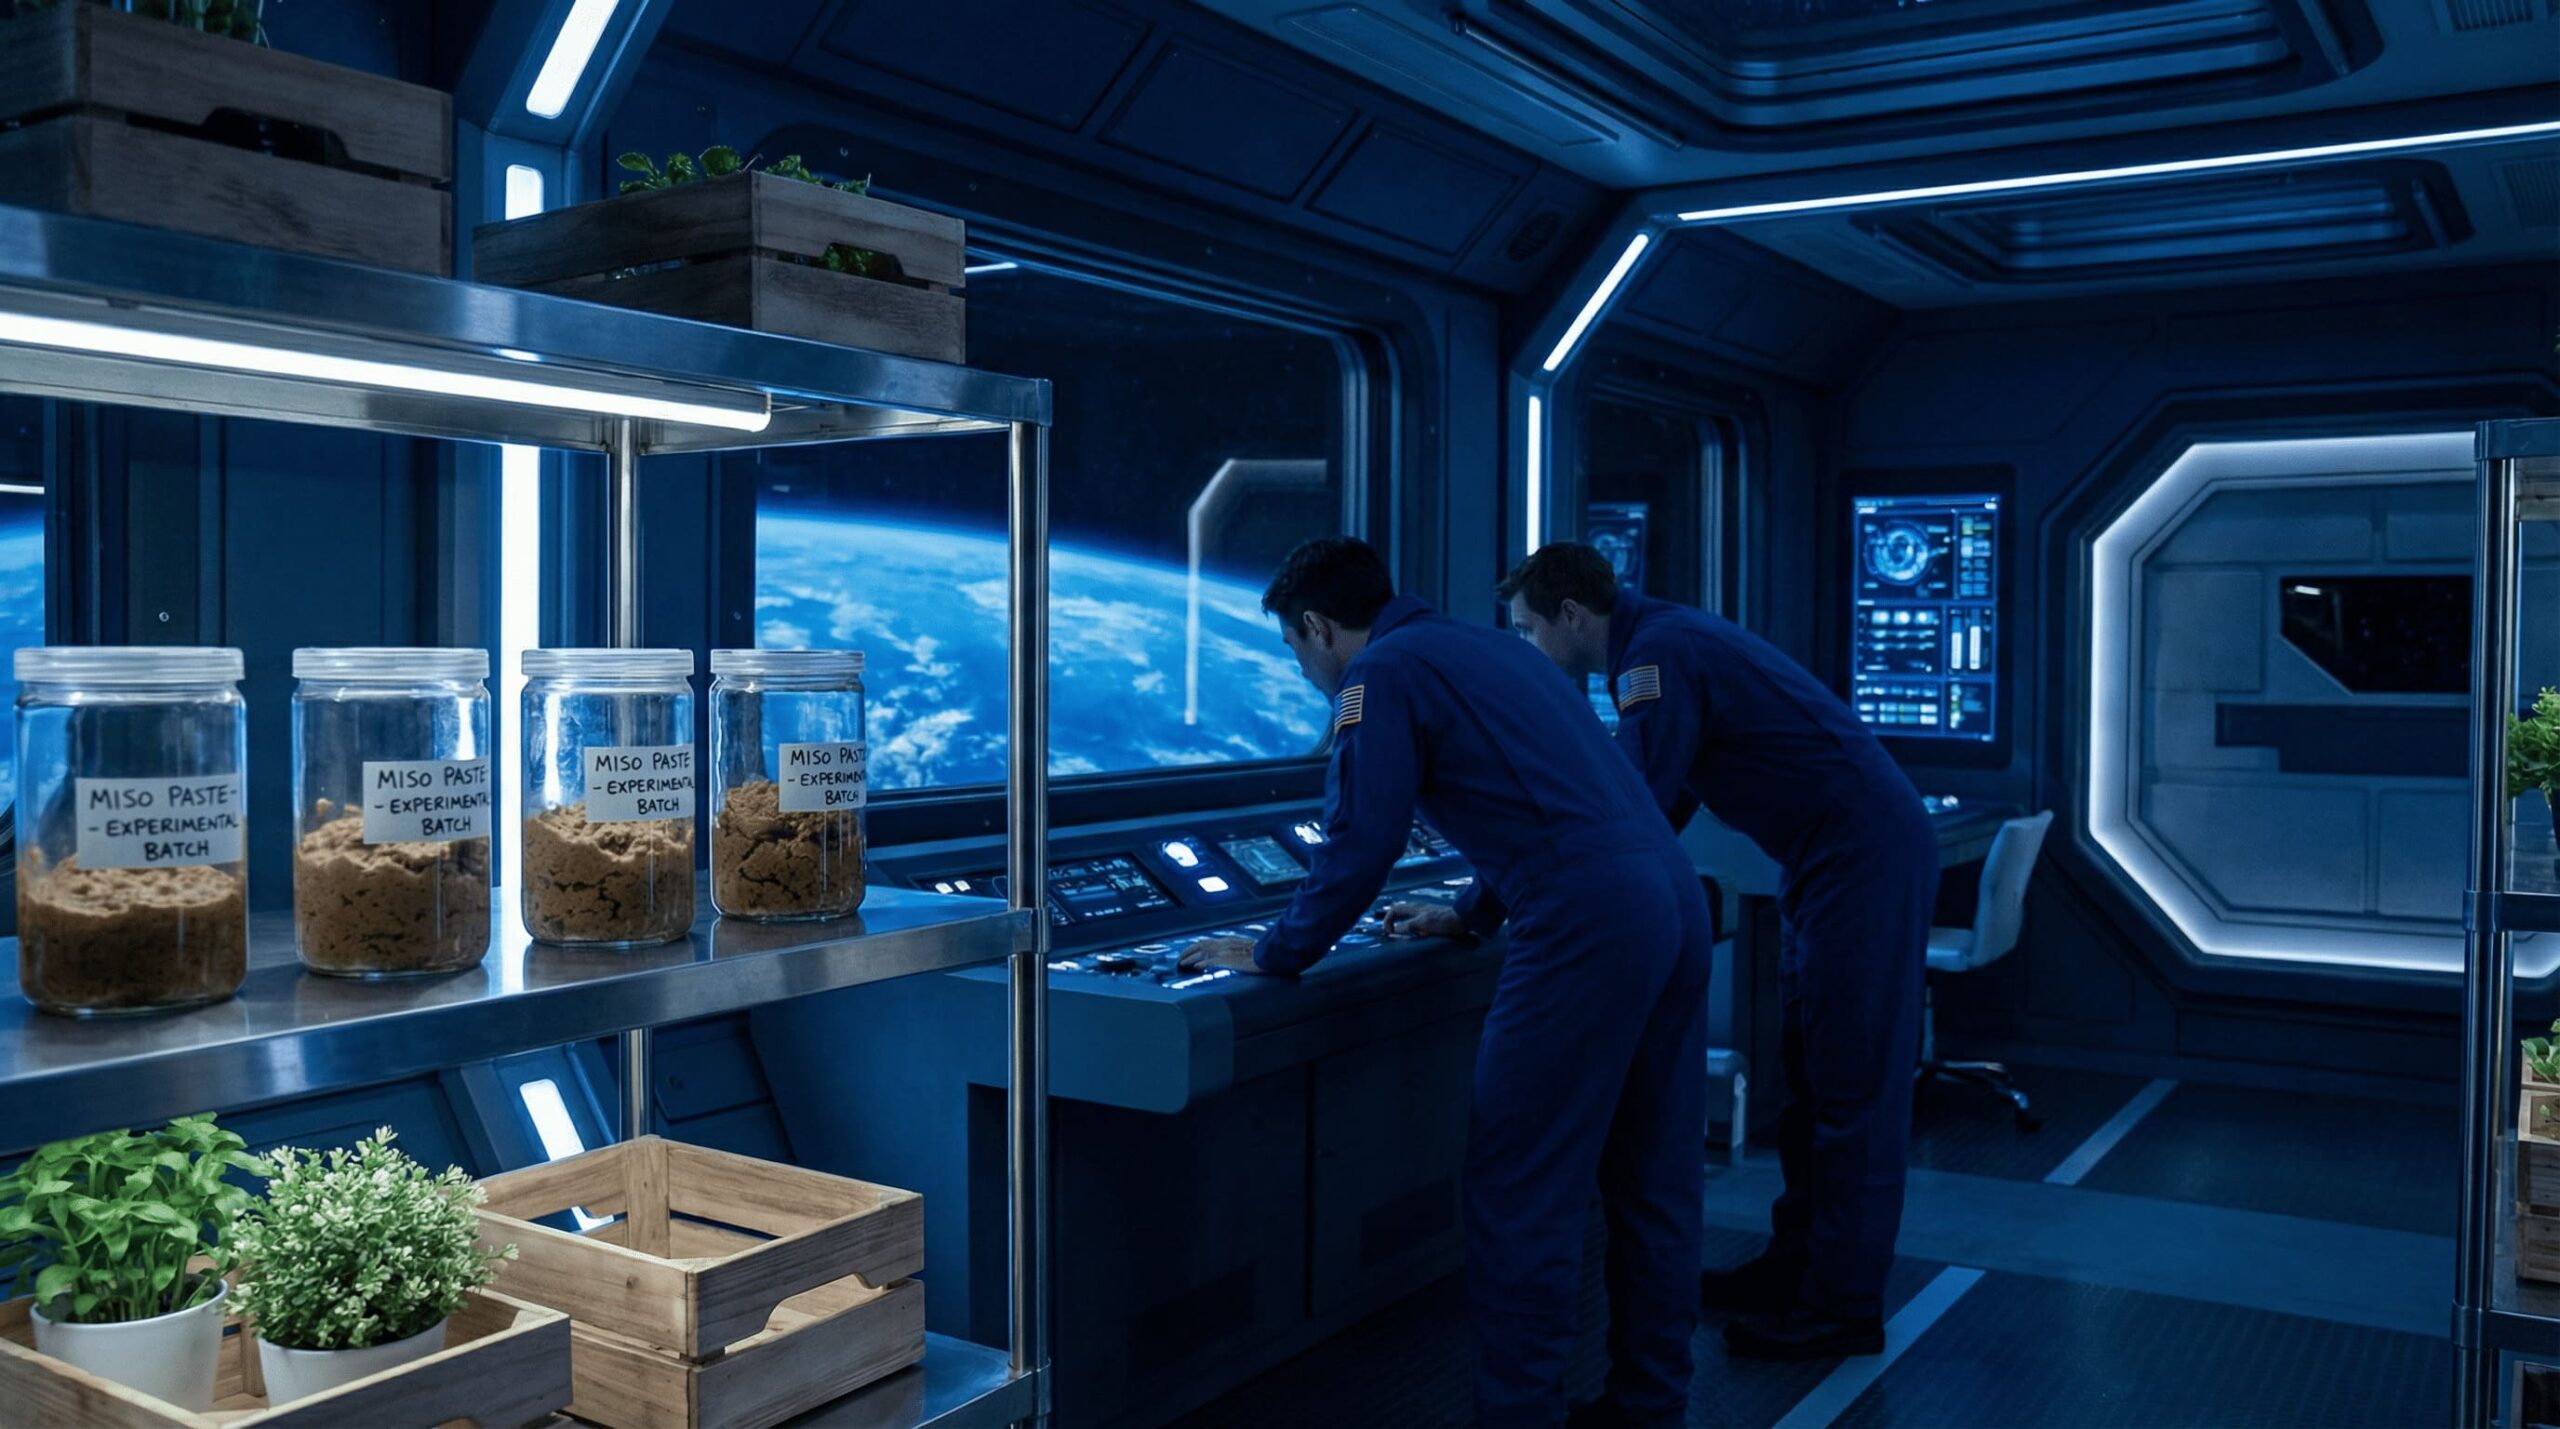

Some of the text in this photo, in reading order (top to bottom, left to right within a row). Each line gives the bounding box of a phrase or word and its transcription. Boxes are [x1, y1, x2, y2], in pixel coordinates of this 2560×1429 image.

[595, 752, 691, 772] MISO PASTE
[790, 749, 832, 766] MISO
[377, 770, 432, 789] MISO
[607, 776, 694, 795] EXPERIMENTA
[90, 788, 154, 810] MISO
[637, 797, 679, 815] BATCH
[825, 790, 859, 805] BATCH
[421, 815, 471, 836] BATCH
[144, 839, 209, 862] BATCH
